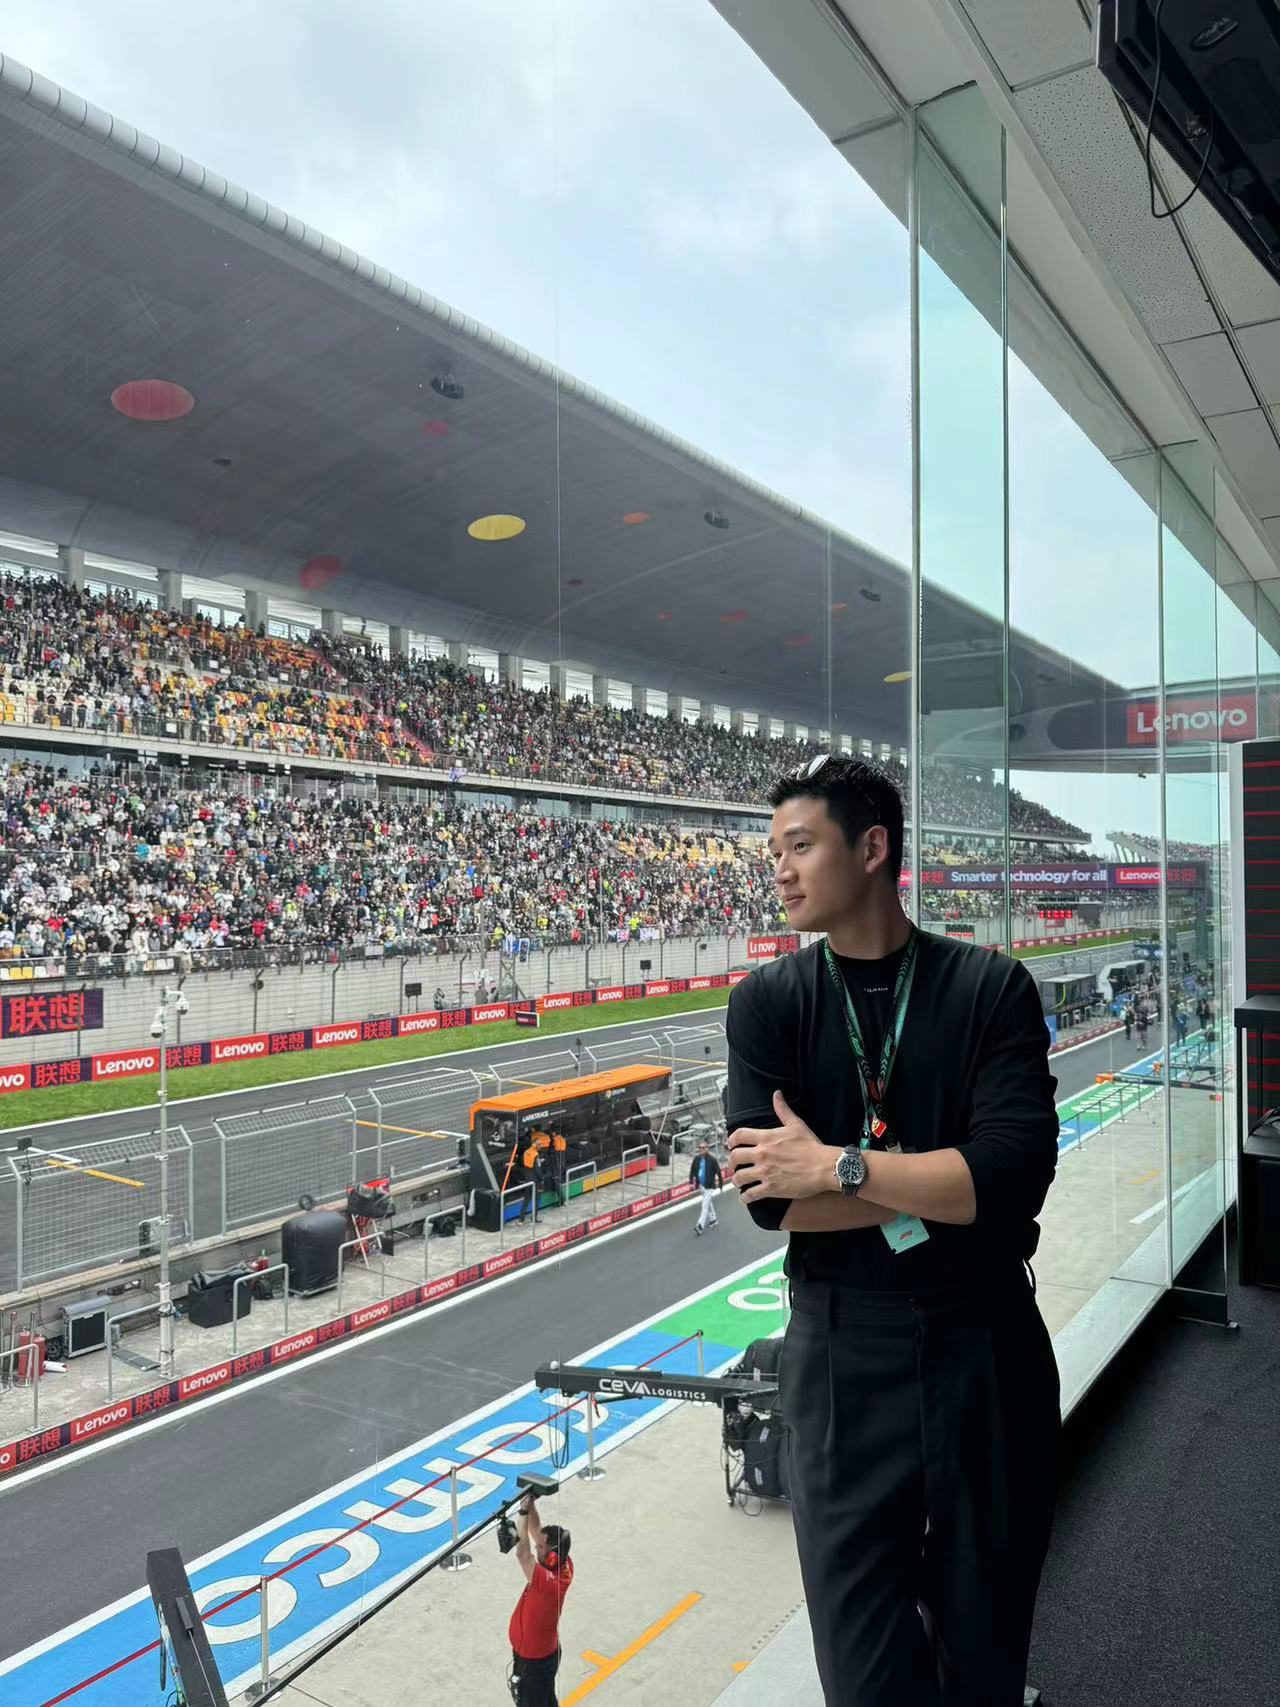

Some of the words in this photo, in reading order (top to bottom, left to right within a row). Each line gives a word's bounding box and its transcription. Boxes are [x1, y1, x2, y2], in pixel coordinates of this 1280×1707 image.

[1137, 708, 1248, 733] Lenovo
[951, 871, 998, 882] Smarter
[1072, 870, 1089, 881] for
[1092, 870, 1107, 881] all
[1120, 871, 1161, 880] Lenovo
[543, 997, 570, 1007] Lenovo
[598, 990, 623, 1001] Lenovo
[9, 992, 85, 1034] 联想
[474, 1008, 505, 1021] Lenovo
[363, 1020, 392, 1039] 联想
[400, 1017, 437, 1032] Lenovo
[271, 1032, 304, 1053] 联想
[315, 1028, 358, 1043] Lenovo
[215, 1041, 264, 1058] Lenovo
[36, 1060, 80, 1088] 联想
[96, 1056, 155, 1075] Lenovo
[424, 1278, 455, 1297] Lenovo
[354, 1305, 389, 1325] Lenovo
[274, 1335, 314, 1357] Lenovo
[183, 1368, 228, 1393] Lenovo
[652, 1388, 706, 1400] LOGISTICS
[76, 1407, 128, 1435] Lenovo
[20, 1428, 61, 1461] 联想
